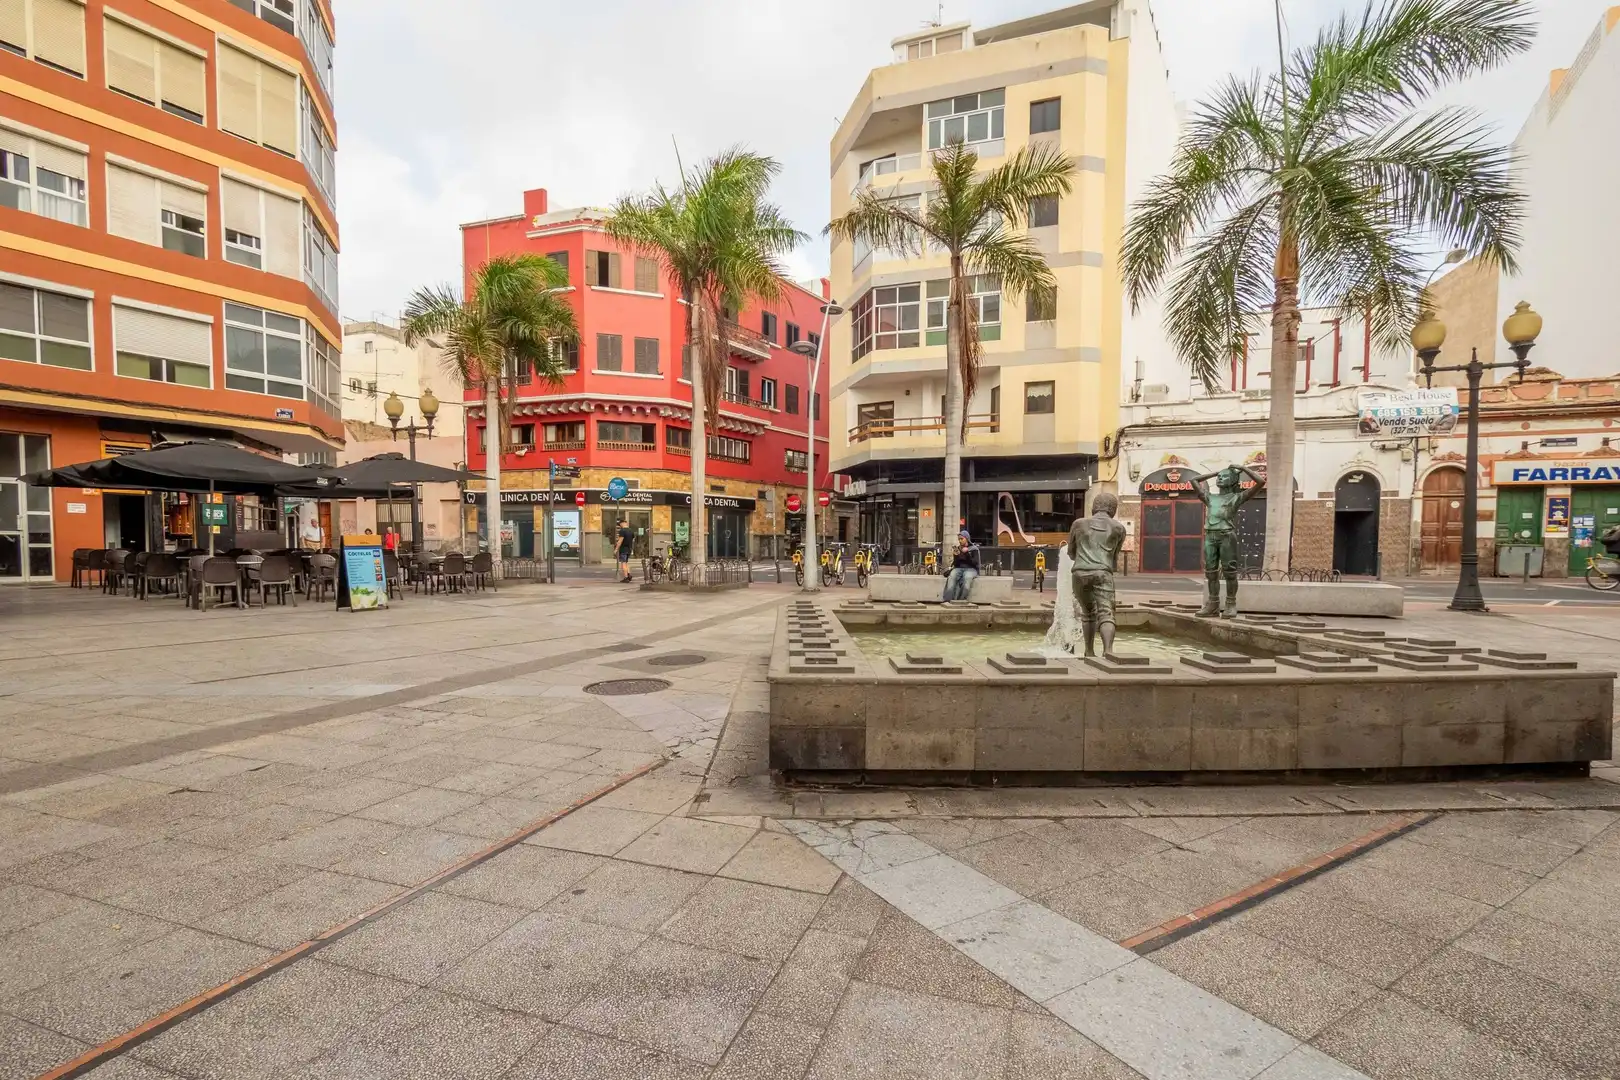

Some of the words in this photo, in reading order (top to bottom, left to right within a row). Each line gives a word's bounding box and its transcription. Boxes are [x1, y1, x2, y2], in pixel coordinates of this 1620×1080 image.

[1389, 393, 1413, 402] Best
[1417, 391, 1451, 399] House
[1379, 417, 1406, 426] Vende
[1408, 416, 1434, 425] Suelo
[500, 492, 529, 502] LÍNICA
[530, 493, 566, 501] DENAL
[714, 498, 740, 507] DENTAL
